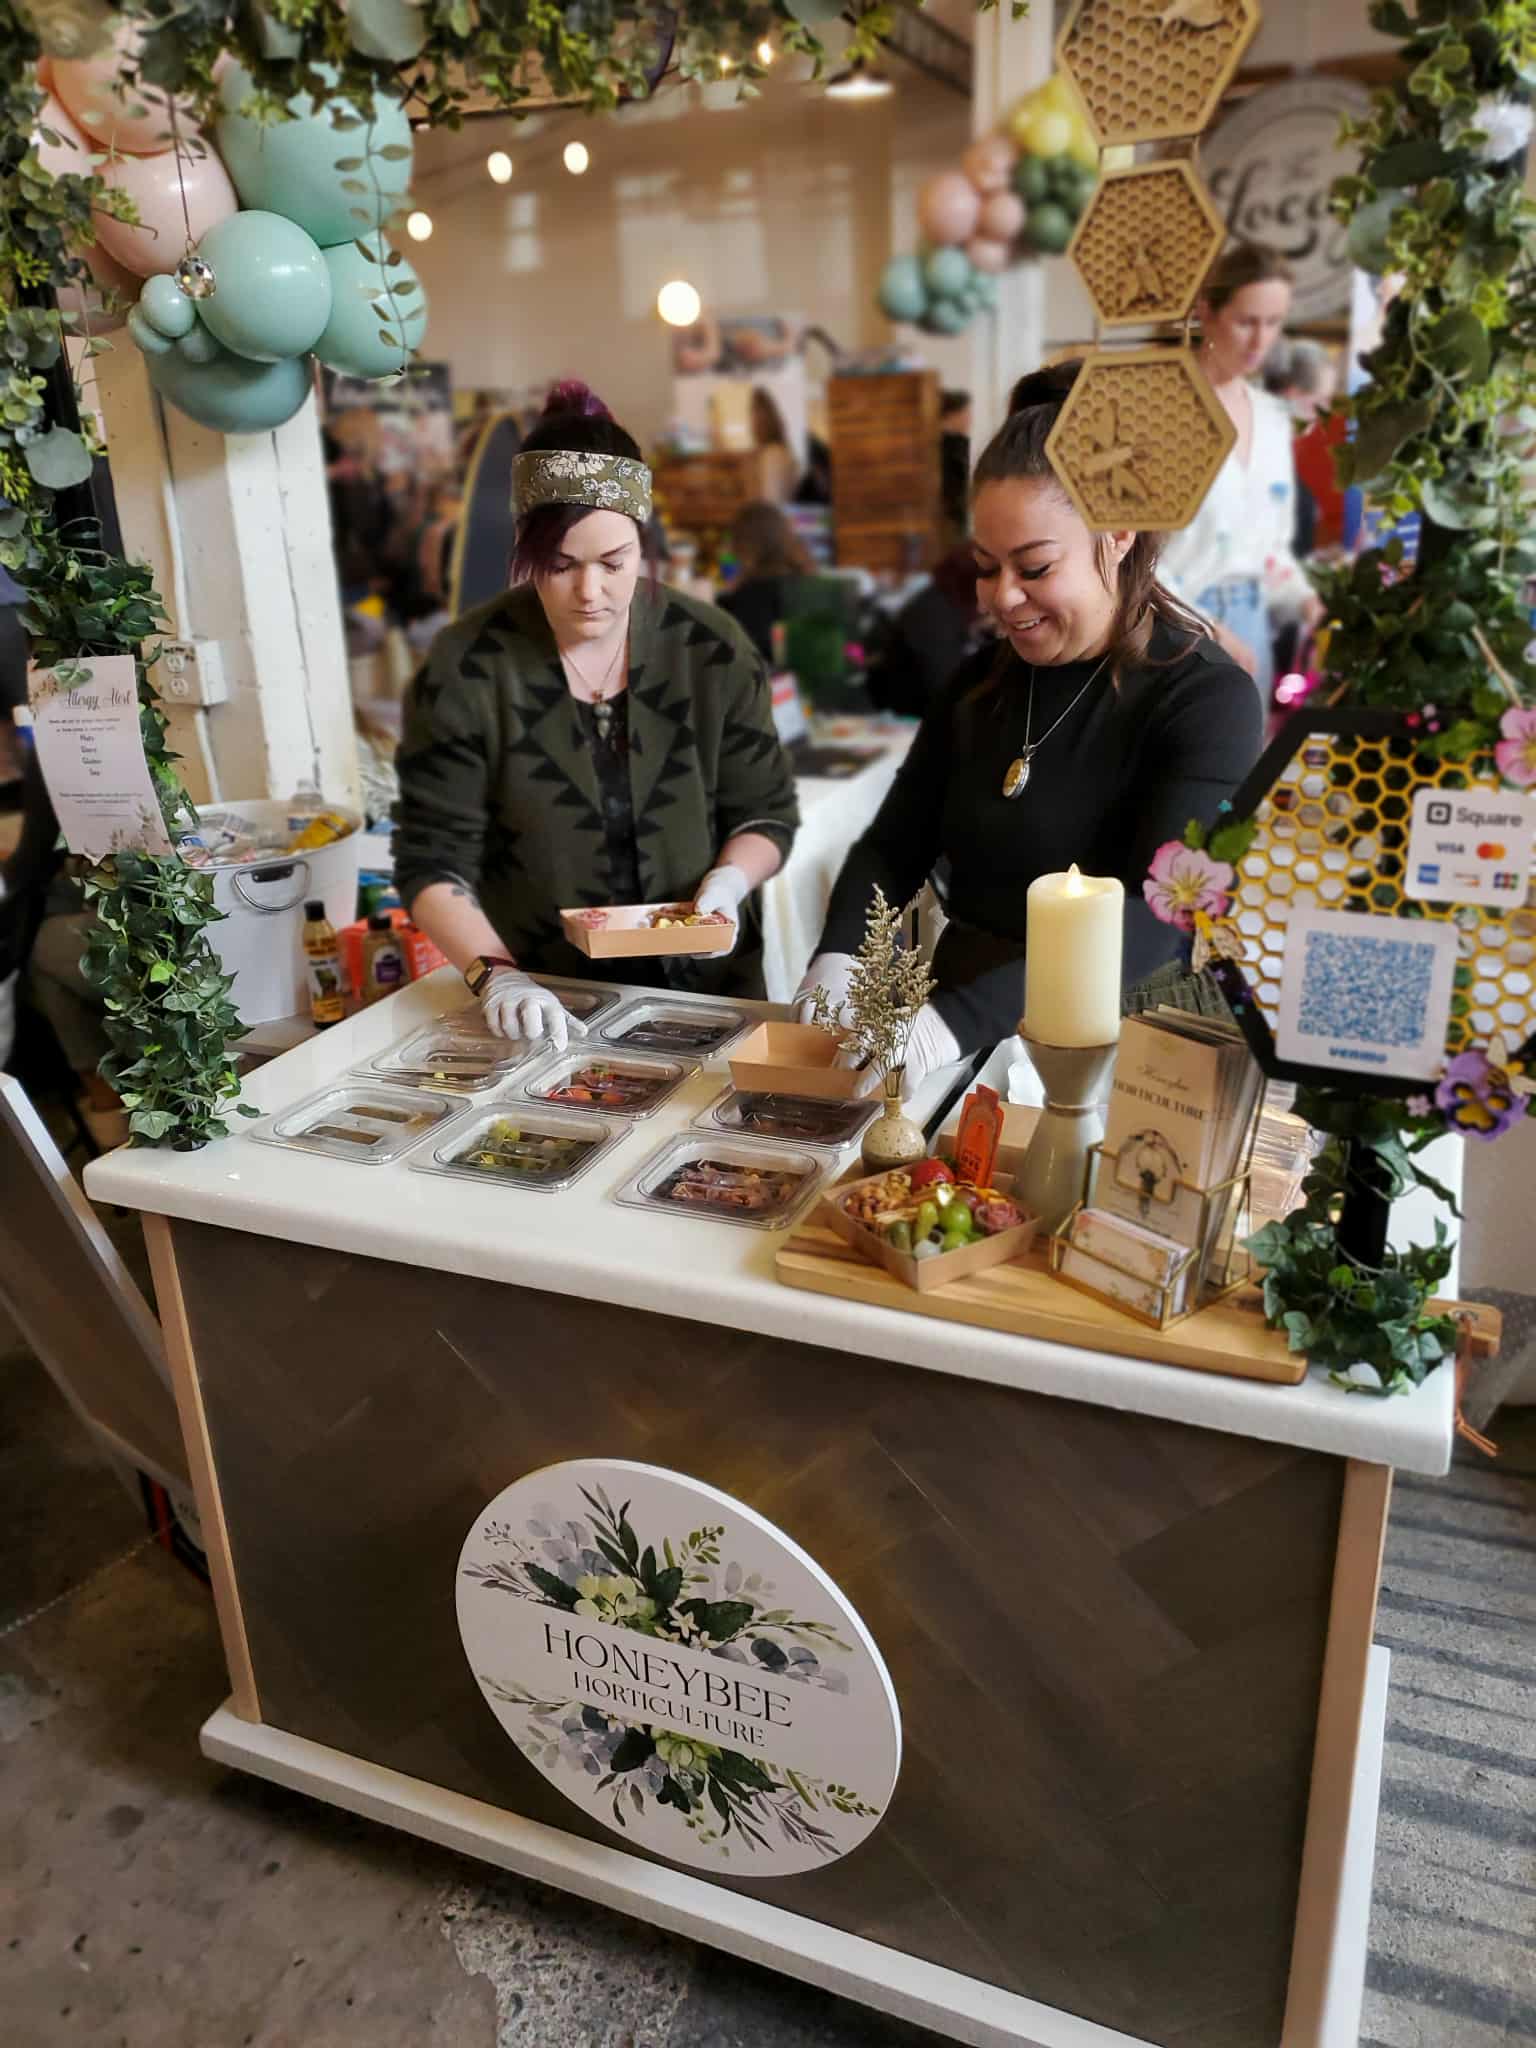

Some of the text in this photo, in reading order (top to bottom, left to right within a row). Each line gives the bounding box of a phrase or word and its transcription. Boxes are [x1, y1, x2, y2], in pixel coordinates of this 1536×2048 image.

[64, 687, 131, 711] Allergy Alert
[1456, 806, 1523, 828] Square
[1436, 842, 1466, 854] VISA
[544, 1622, 793, 1728] HONEYBEE
[573, 1671, 767, 1748] HORTICULTURE
